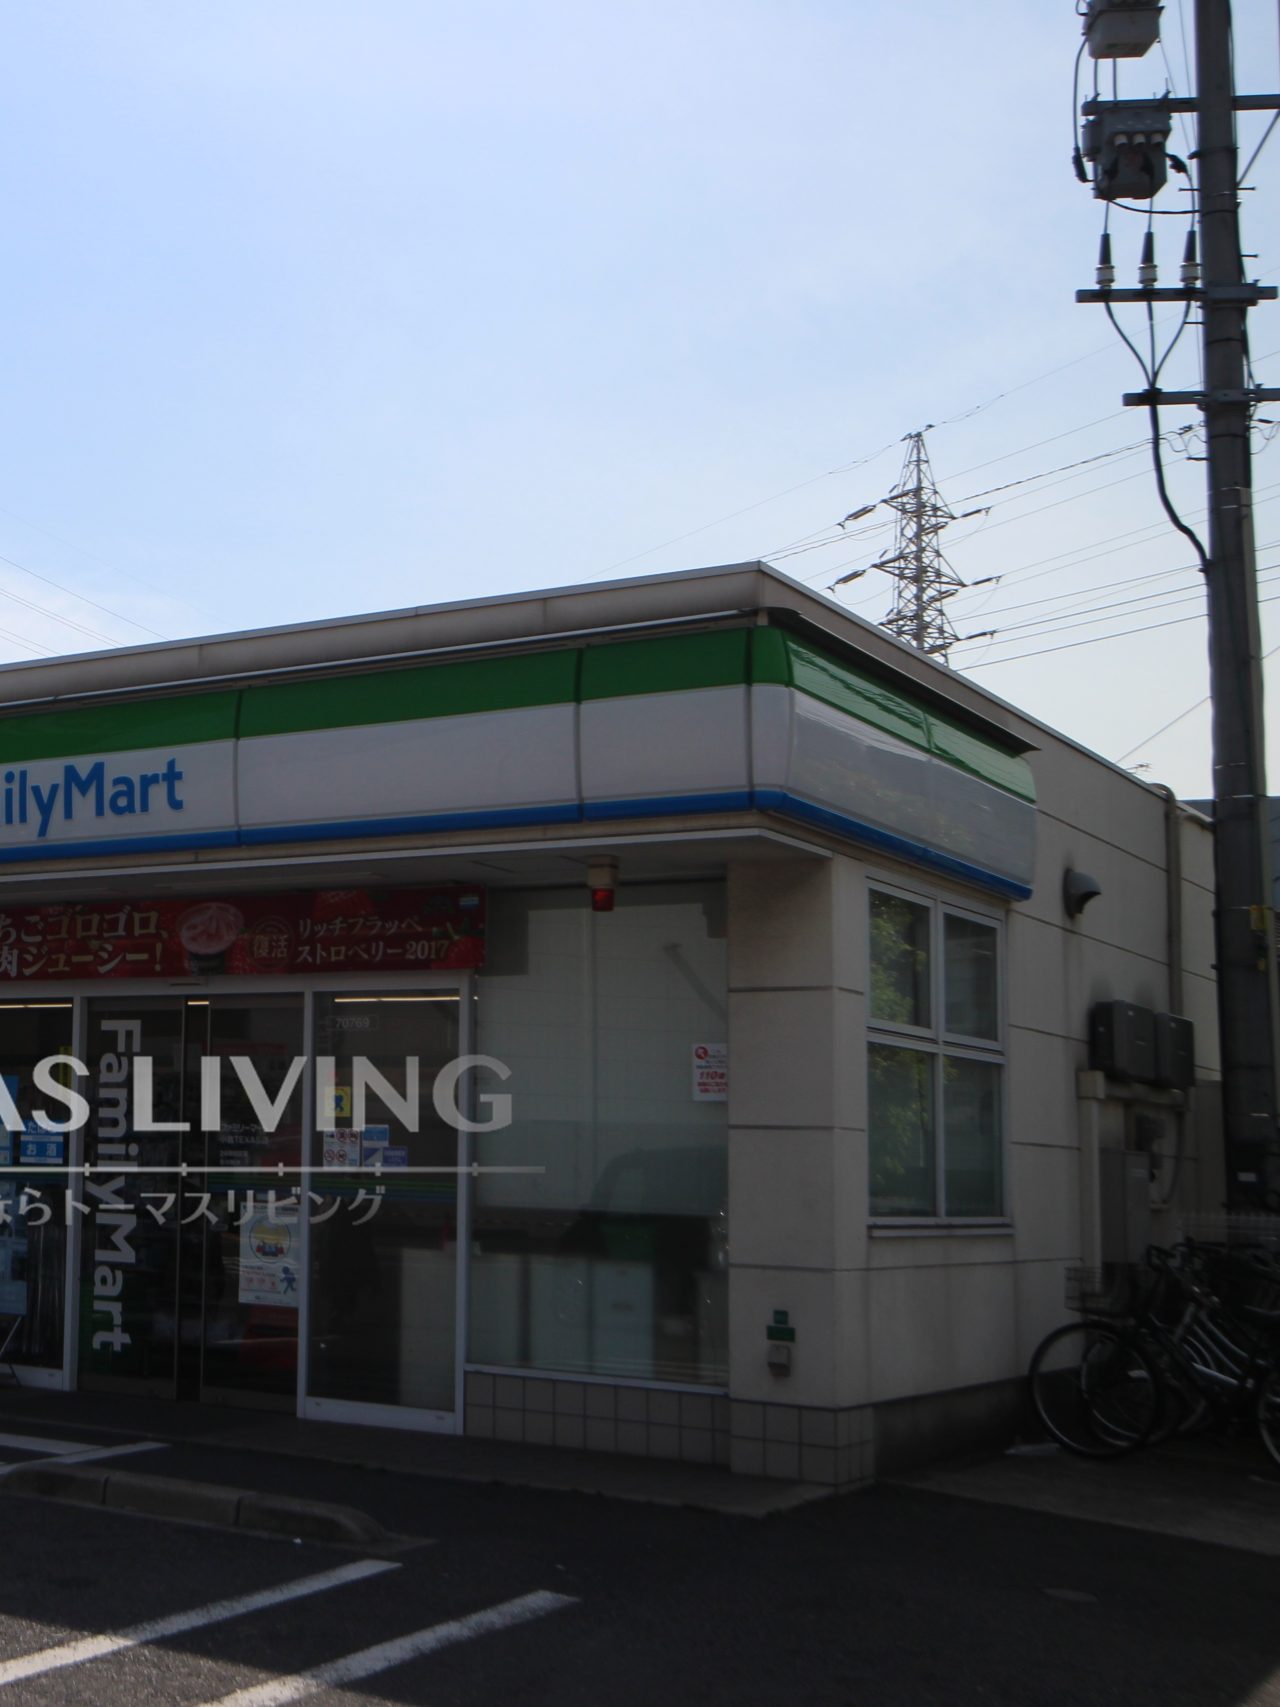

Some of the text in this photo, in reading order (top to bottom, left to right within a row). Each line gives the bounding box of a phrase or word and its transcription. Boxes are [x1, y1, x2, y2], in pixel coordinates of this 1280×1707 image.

[253, 934, 289, 960] 復活
[335, 1017, 370, 1029] 70769
[86, 1018, 141, 1353] FamilyMart
